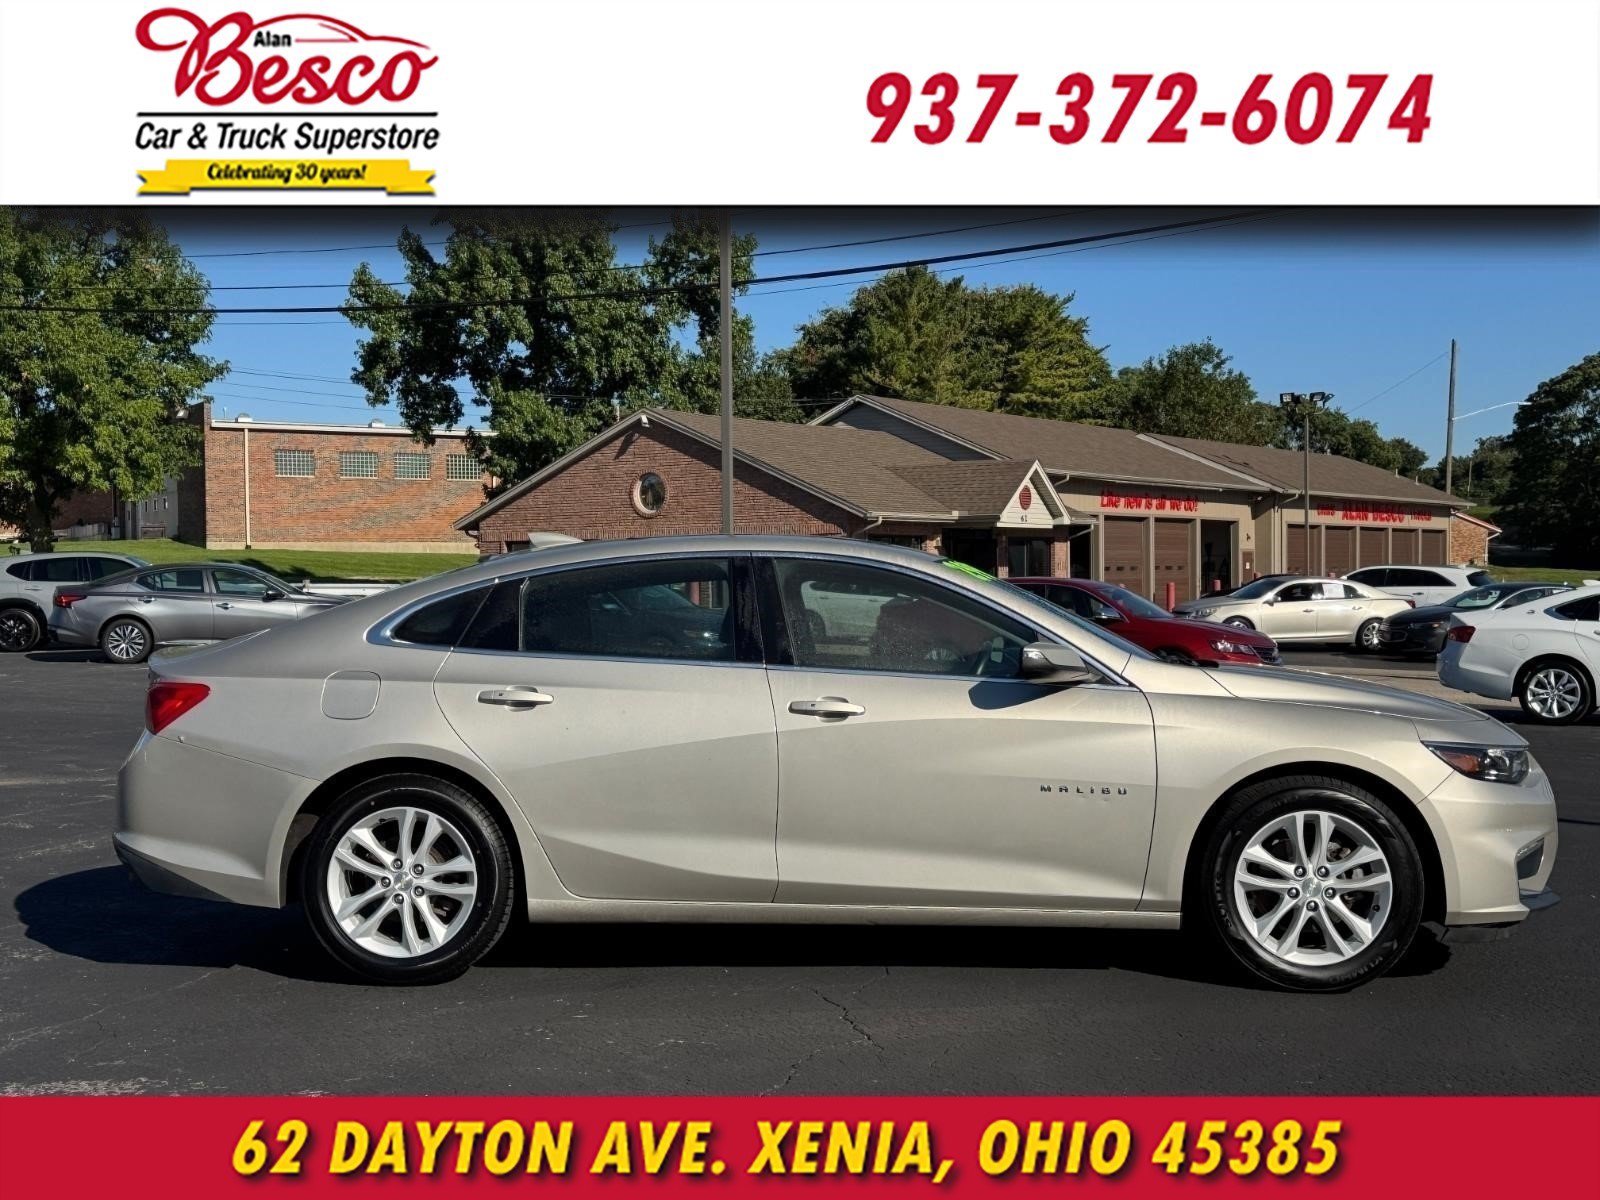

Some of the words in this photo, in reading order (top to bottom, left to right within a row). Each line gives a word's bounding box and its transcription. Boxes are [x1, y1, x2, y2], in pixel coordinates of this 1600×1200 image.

[1124, 496, 1142, 511] new
[1145, 493, 1153, 510] is
[1040, 785, 1127, 795] MALIBU
